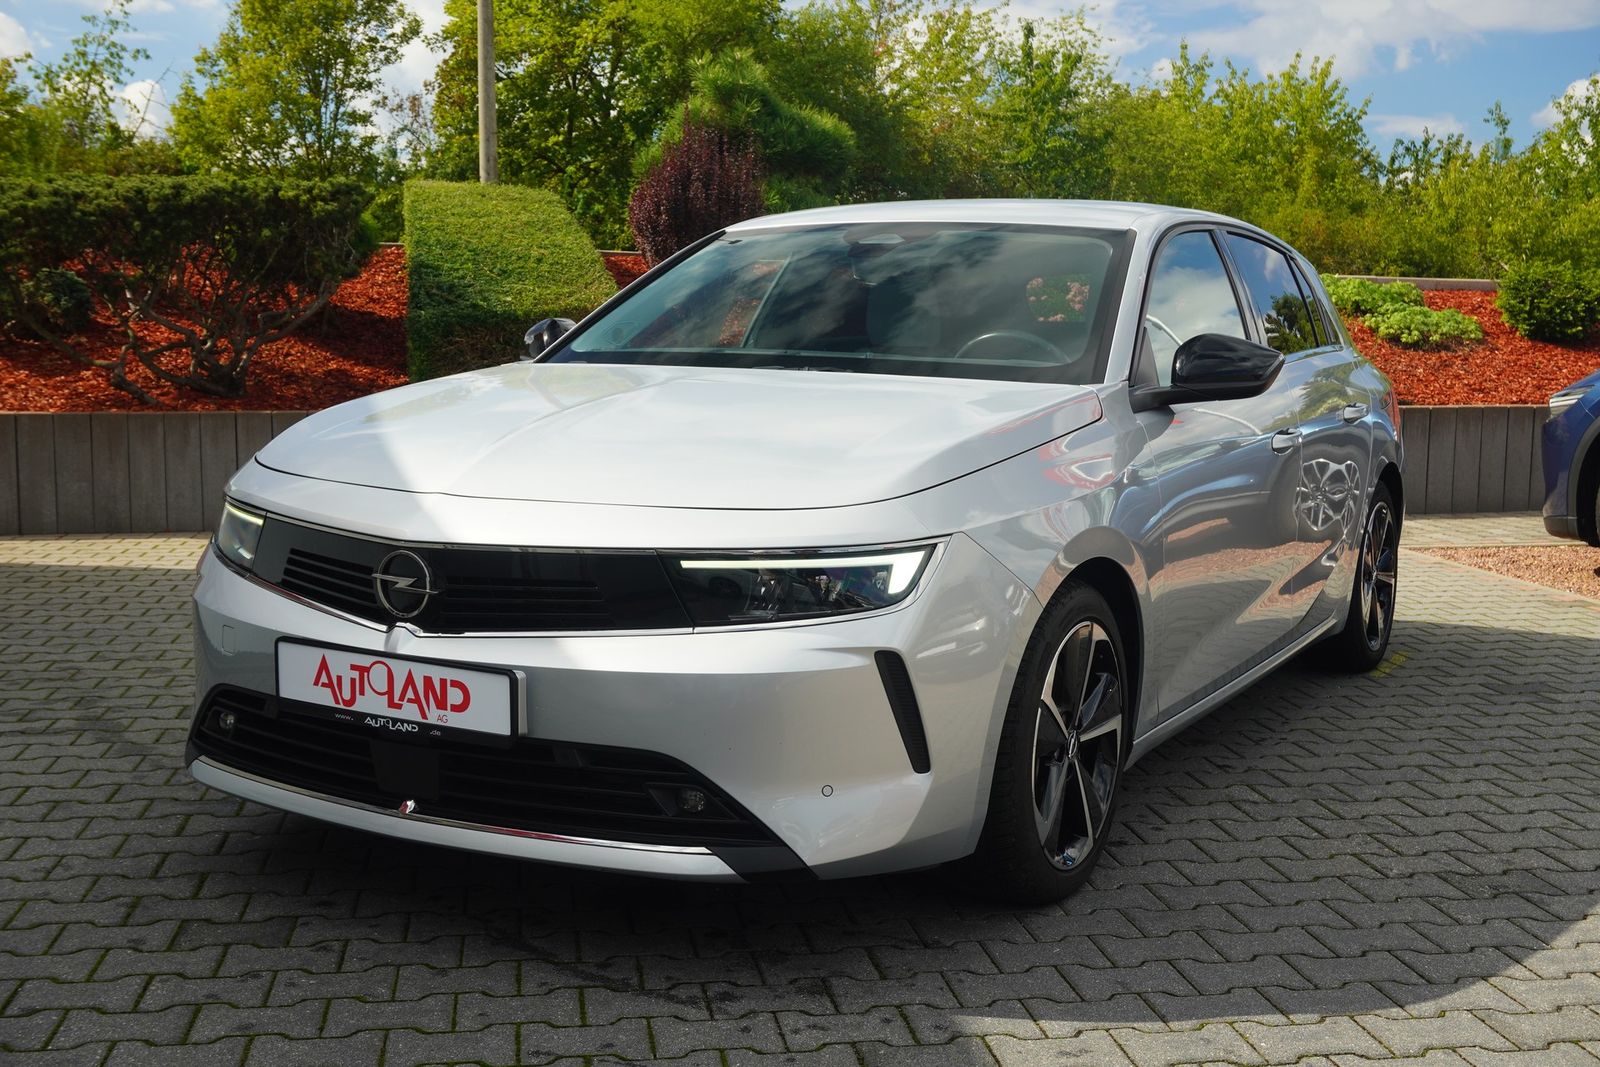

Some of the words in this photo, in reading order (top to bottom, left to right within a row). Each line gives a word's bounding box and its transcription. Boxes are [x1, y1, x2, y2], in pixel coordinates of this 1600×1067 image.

[313, 653, 471, 721] AUTOLAND
[364, 716, 419, 732] AUTOLAND
[437, 713, 449, 724] AG
